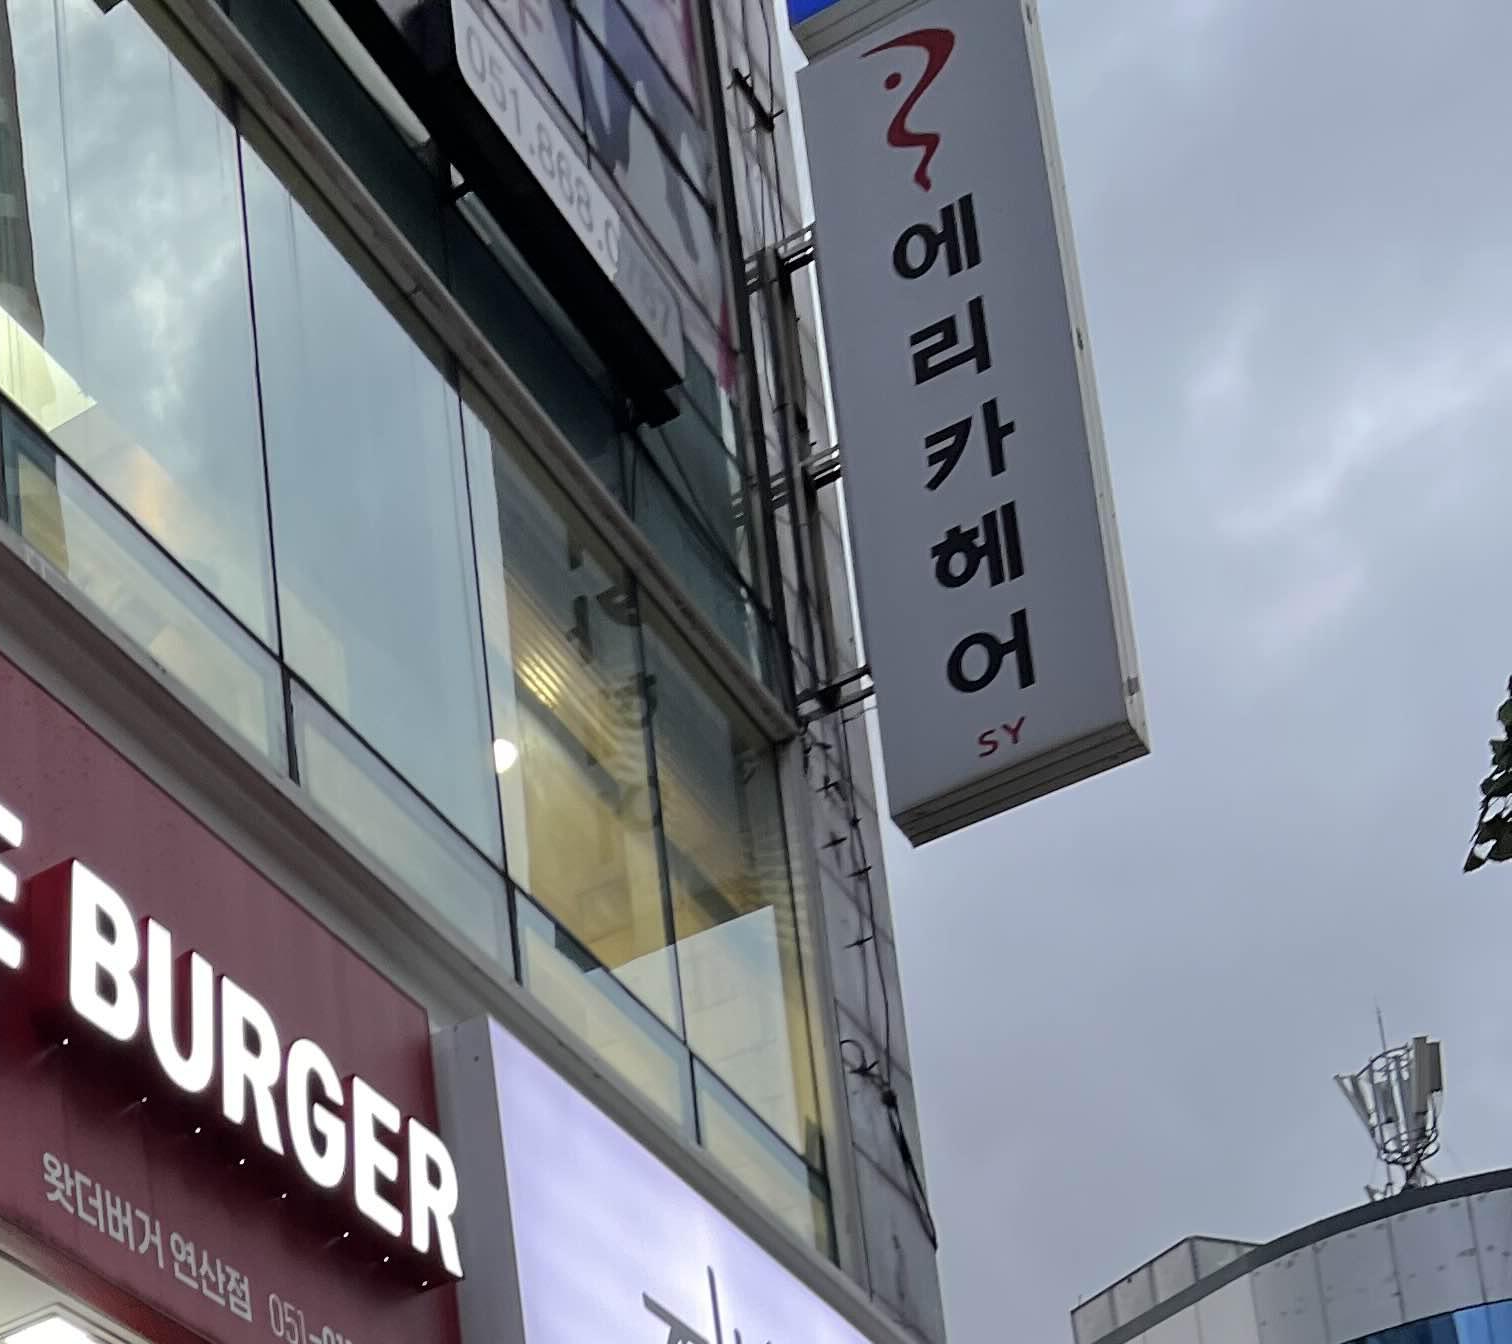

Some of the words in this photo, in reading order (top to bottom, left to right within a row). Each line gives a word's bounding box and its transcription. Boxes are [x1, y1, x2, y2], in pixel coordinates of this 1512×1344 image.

[892, 192, 1036, 695] 에리카헤어
[978, 717, 1028, 757] SY
[68, 857, 463, 1279] BURGER
[42, 1151, 165, 1269] 왓더버거
[170, 1231, 253, 1323] 연산점
